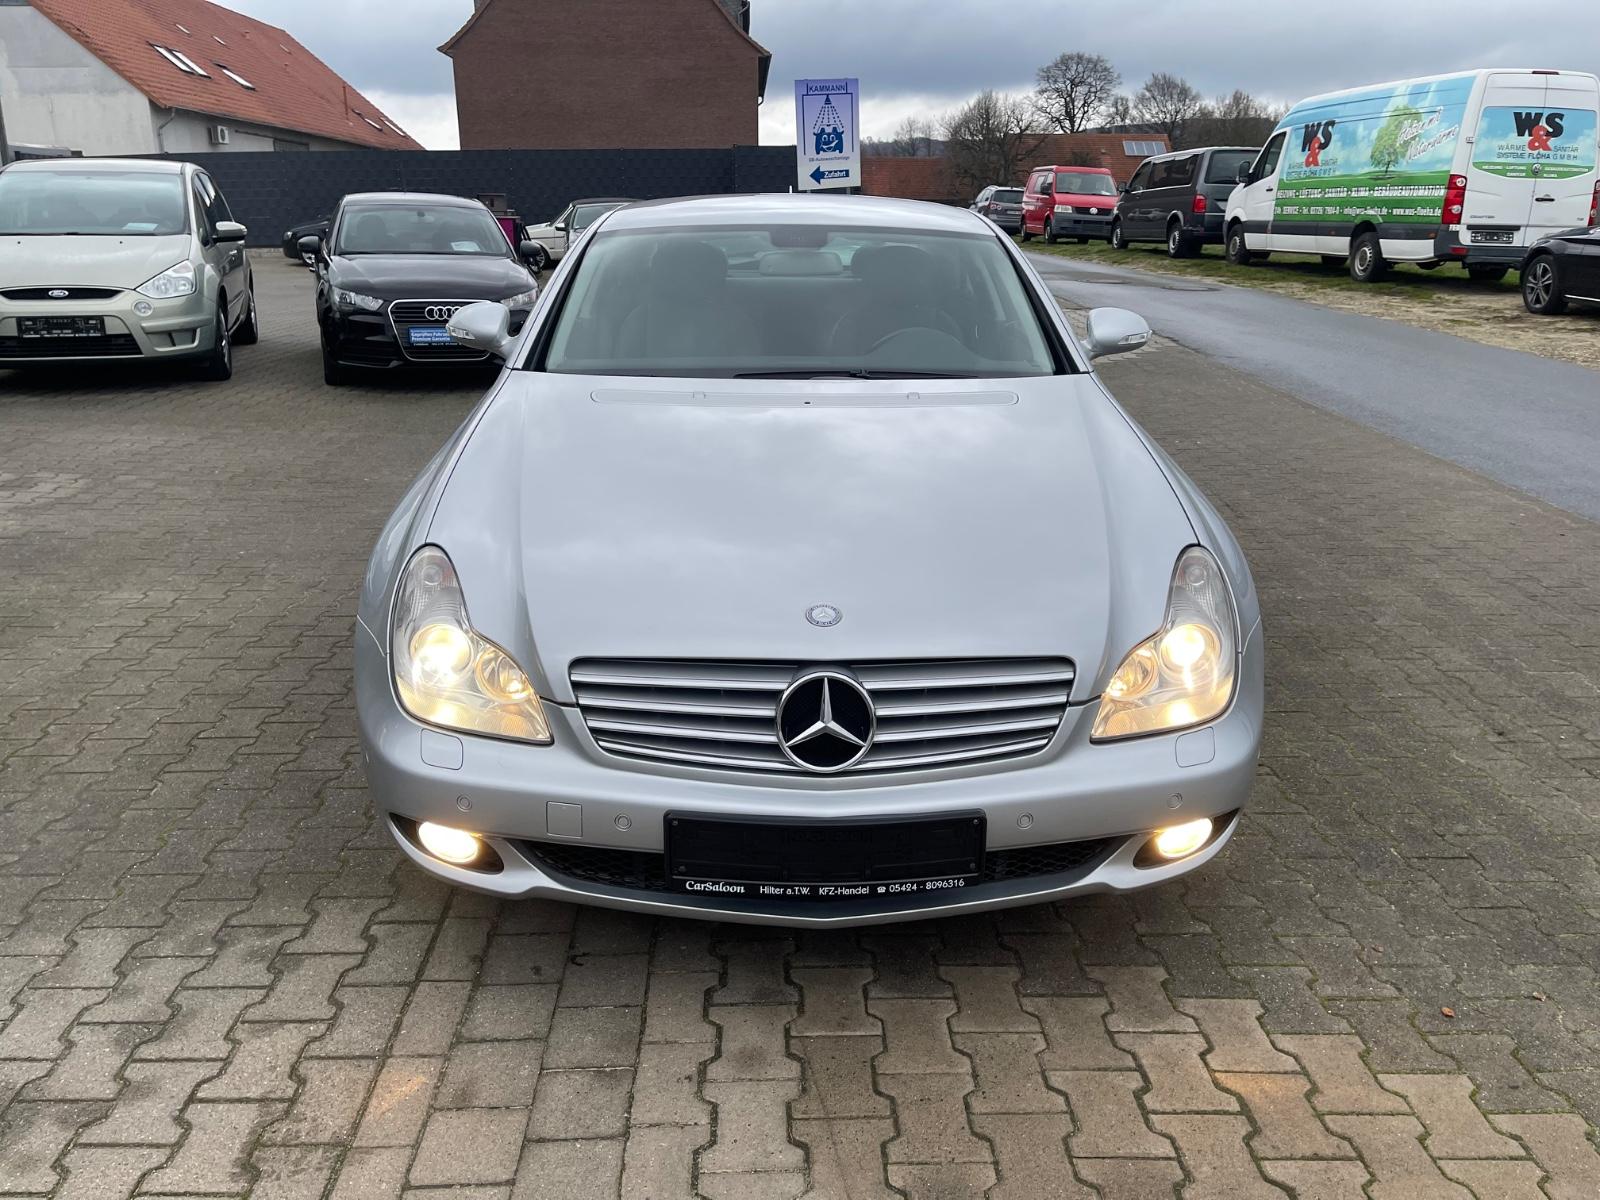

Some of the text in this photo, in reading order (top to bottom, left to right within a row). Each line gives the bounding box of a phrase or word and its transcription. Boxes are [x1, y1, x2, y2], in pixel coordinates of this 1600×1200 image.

[808, 84, 846, 93] KAMMANN
[1513, 111, 1565, 151] W&S
[1301, 119, 1336, 167] W&S
[1553, 145, 1579, 153] SANITÄR
[1528, 151, 1551, 160] FLÖHA
[824, 171, 846, 179] Zufahrt
[1373, 183, 1446, 197] GEBÄUDEAUTOMATION
[685, 881, 745, 893] CarSaloon
[760, 886, 784, 894] Hilter
[786, 887, 810, 895] a.T.W.
[819, 886, 869, 895] KFZ-Handel
[889, 884, 917, 892] 05424
[926, 879, 964, 890] 8096316
